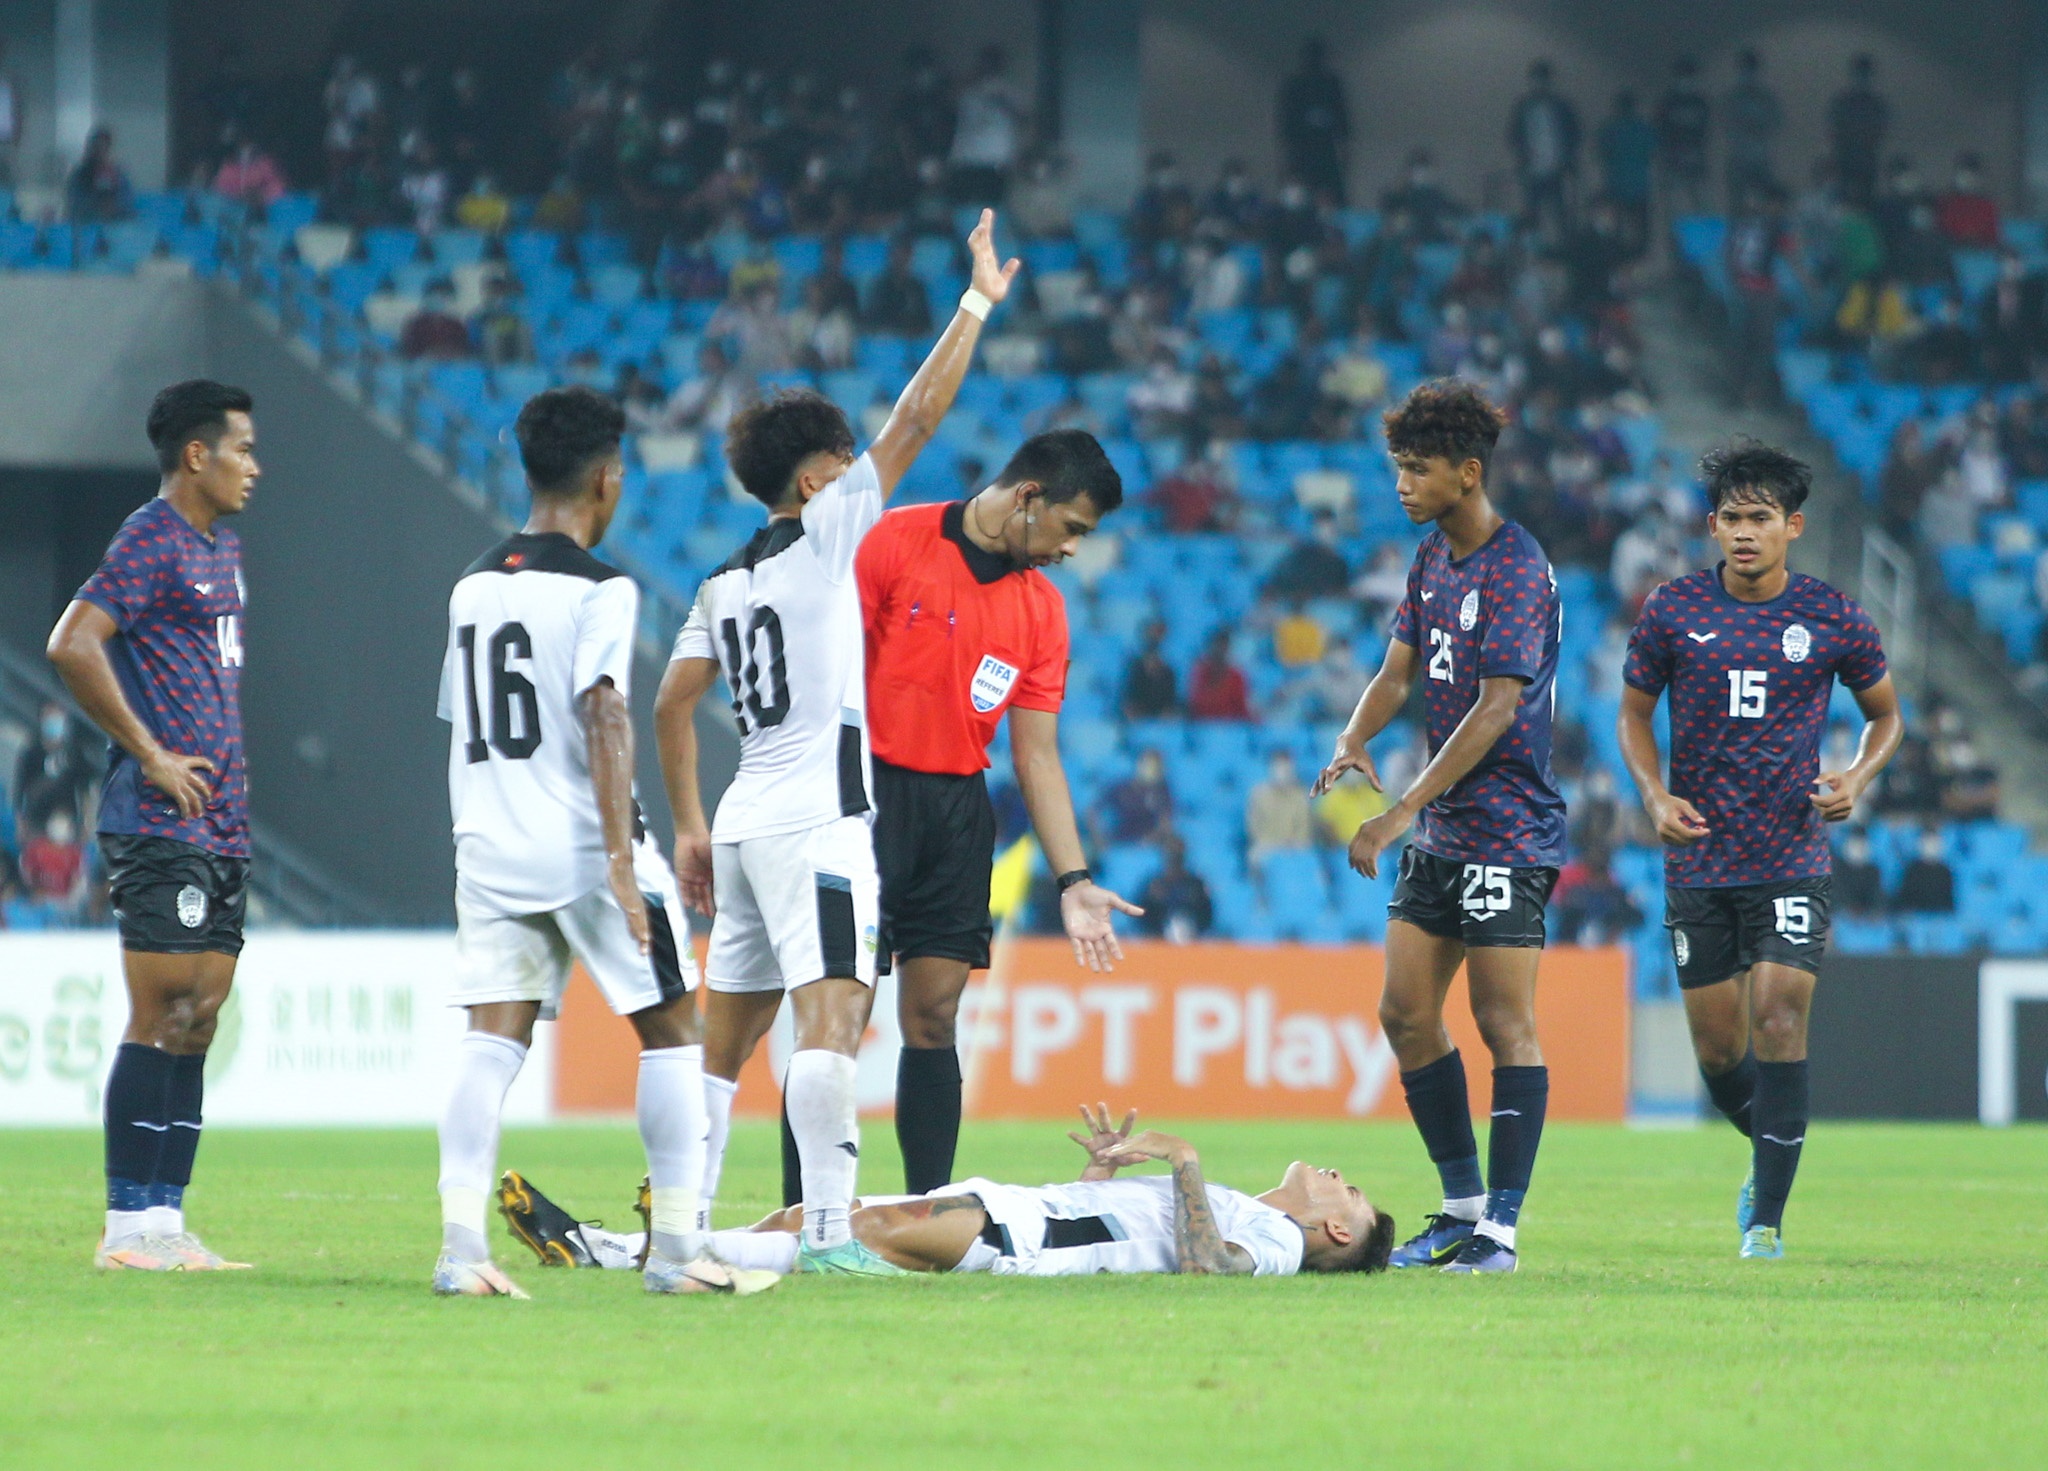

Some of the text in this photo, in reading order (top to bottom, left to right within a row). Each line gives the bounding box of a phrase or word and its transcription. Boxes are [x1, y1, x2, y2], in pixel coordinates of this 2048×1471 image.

[216, 614, 245, 668] 14
[1429, 627, 1454, 685] 25
[456, 621, 542, 764] 16
[720, 605, 791, 736] 10
[975, 678, 1004, 697] REFEREE
[982, 659, 1011, 682] FIFA
[1727, 669, 1768, 718] 15
[1463, 864, 1511, 911] 25
[1772, 896, 1810, 934] 15
[956, 984, 1397, 1117] FPT Play
